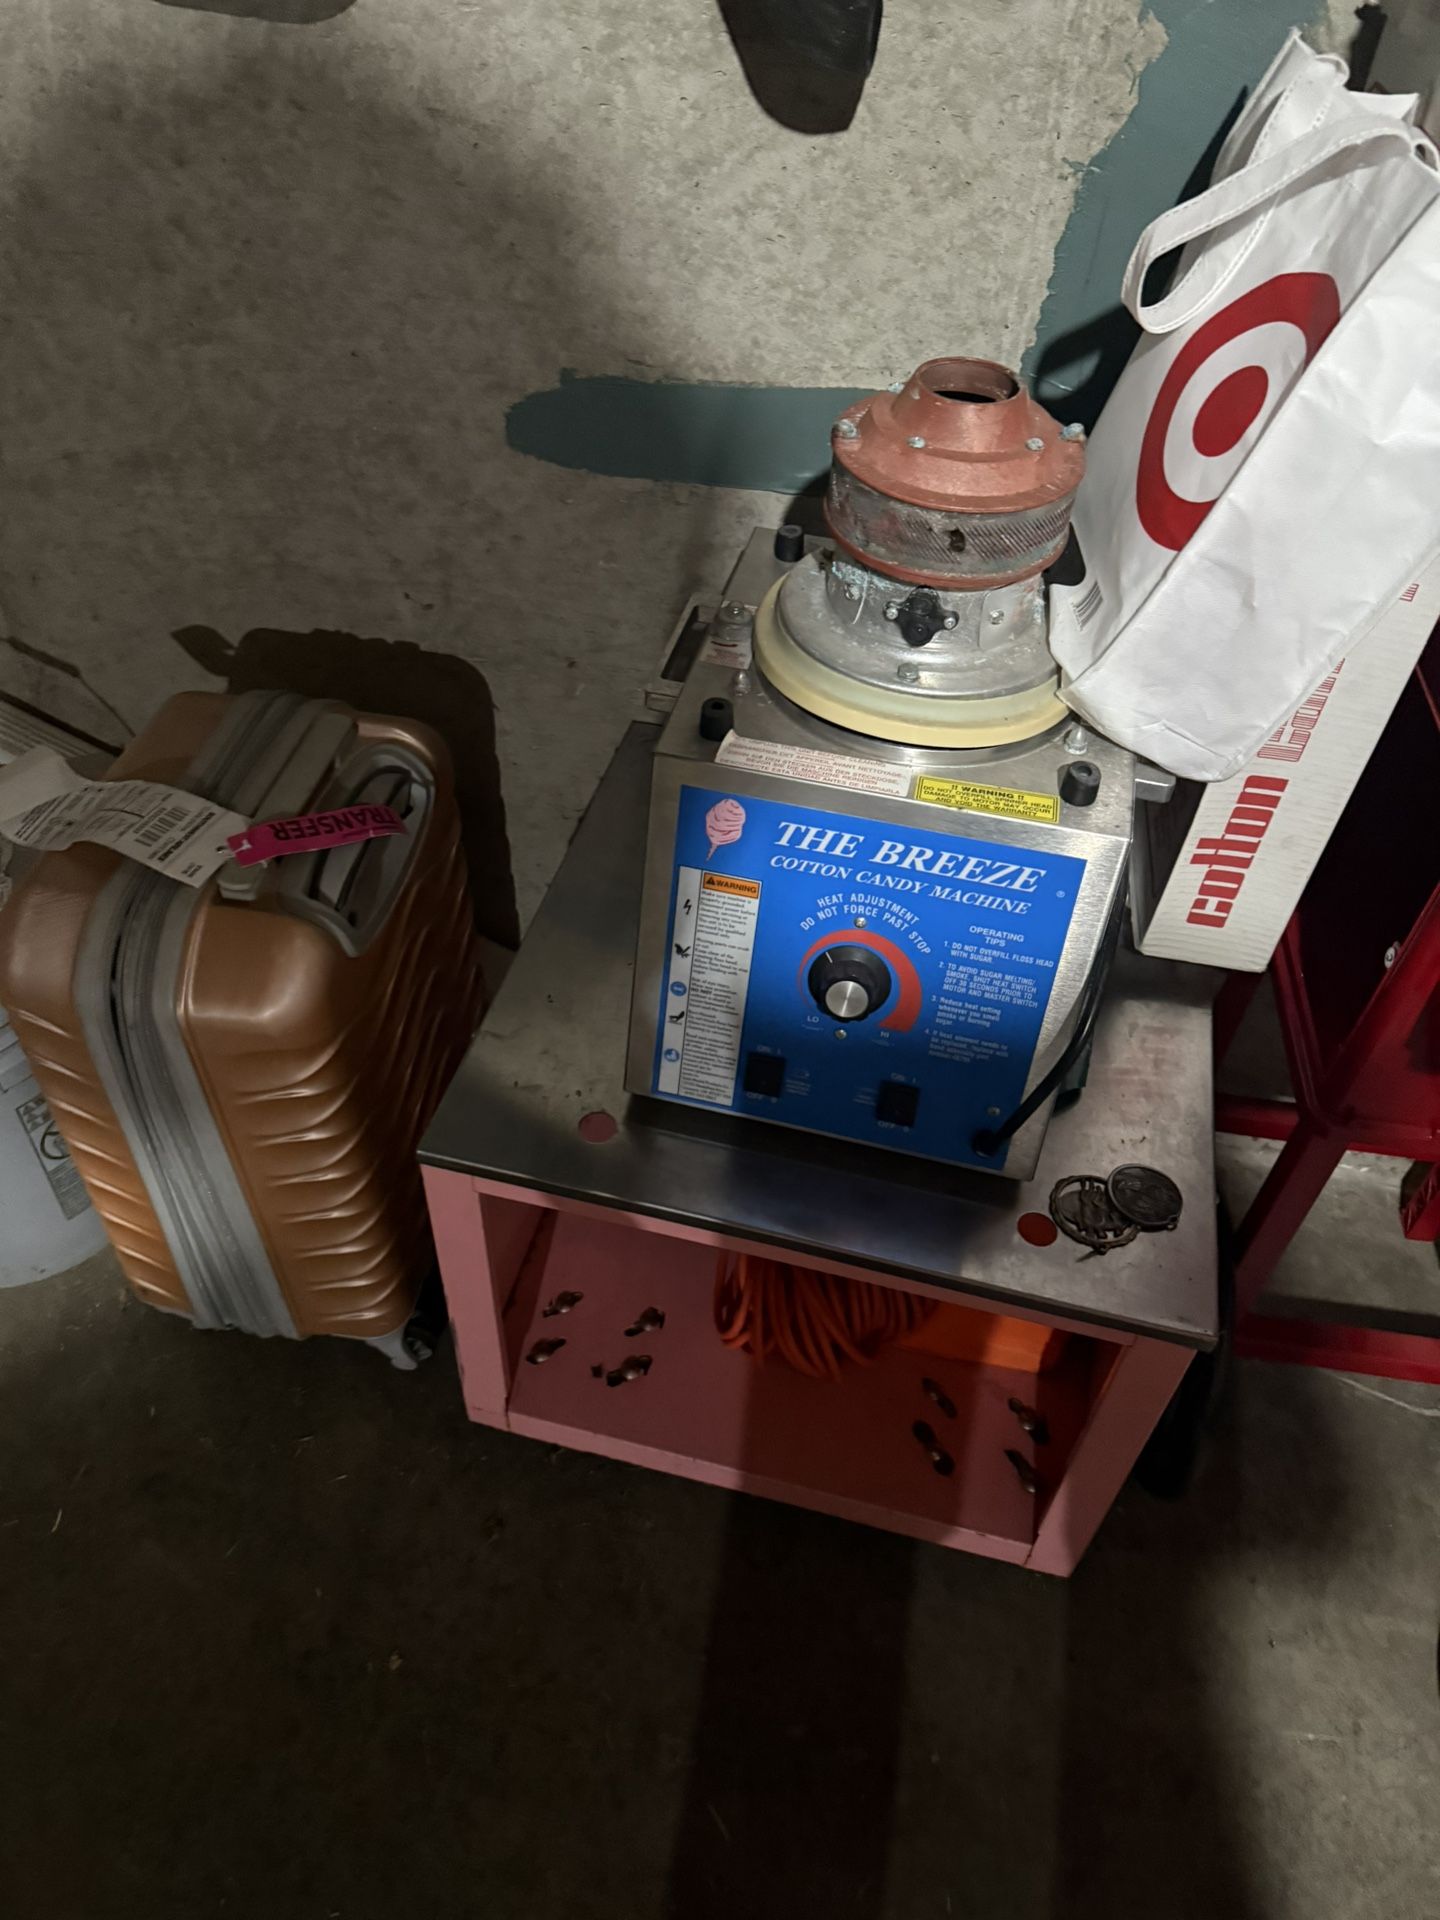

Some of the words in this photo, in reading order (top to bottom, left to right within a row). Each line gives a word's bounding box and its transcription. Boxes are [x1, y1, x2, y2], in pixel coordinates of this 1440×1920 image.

[961, 786, 1013, 798] WARNING
[267, 805, 396, 841] TRANSFER
[773, 821, 862, 859] THE
[868, 839, 1047, 894] BREEZE
[1186, 774, 1289, 928] cotton
[715, 881, 756, 894] WARNING
[770, 855, 852, 881] COTTON
[856, 870, 930, 896] CANDY
[927, 884, 1030, 916] MACHINE
[816, 892, 846, 909] HEAT
[850, 892, 920, 926] ADJUSTMENT
[800, 916, 817, 932] DO
[815, 905, 842, 923] NOT
[843, 904, 879, 919] FORCE
[881, 910, 911, 933] PAST
[907, 929, 932, 956] STOP
[969, 925, 1024, 942] OPERATING
[984, 936, 1006, 947] TIPS
[950, 950, 967, 958] WITH
[952, 942, 963, 950] DO
[965, 944, 977, 953] NOT
[979, 947, 1010, 959] OVERFILL
[1012, 954, 1032, 964] FLOSS
[1034, 958, 1053, 968] HEAD
[958, 965, 977, 974] AVOID
[980, 969, 1002, 979] SUGAR
[969, 982, 998, 993] SECONDS
[1001, 989, 1021, 997] PRIOR
[973, 975, 990, 984] SHUT
[992, 979, 1008, 988] HEAT
[1011, 983, 1036, 993] SWITCH
[943, 984, 966, 993] MOTOR
[984, 992, 1009, 1002] MASTER
[1012, 998, 1037, 1008] SWITCH
[806, 1014, 821, 1023] LO
